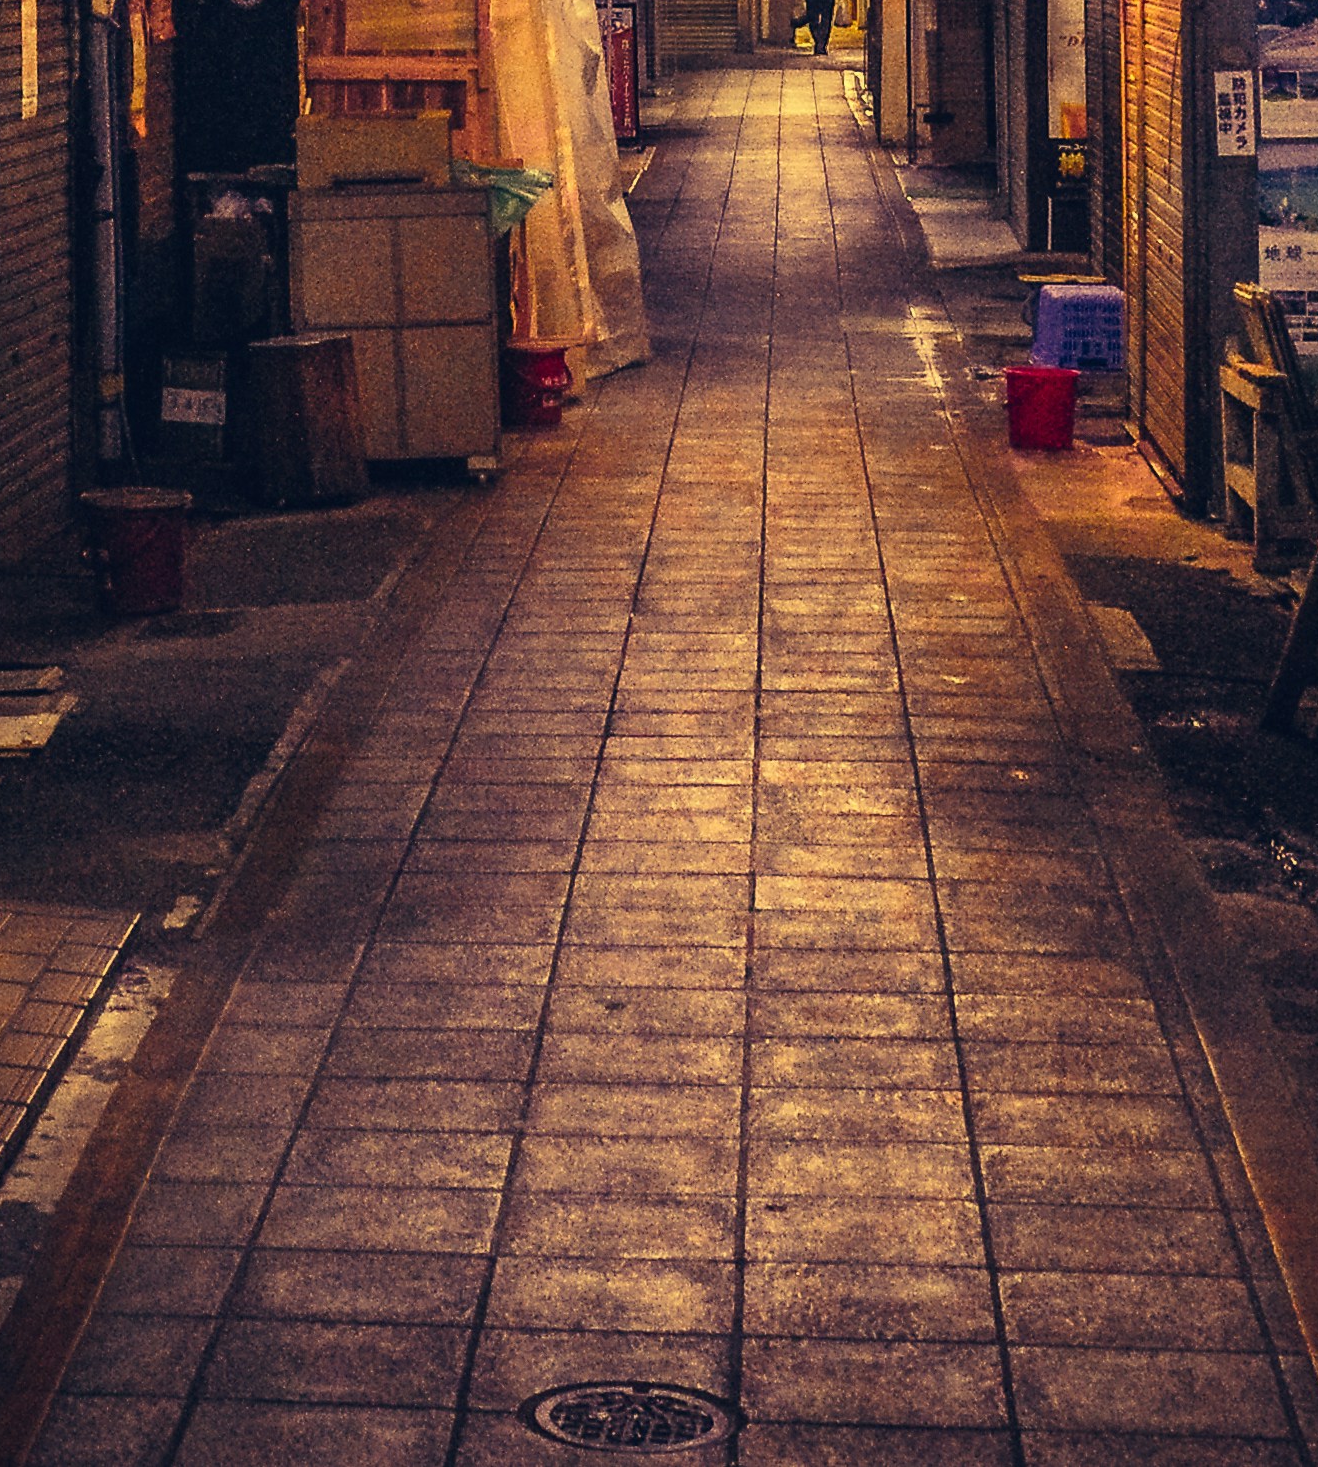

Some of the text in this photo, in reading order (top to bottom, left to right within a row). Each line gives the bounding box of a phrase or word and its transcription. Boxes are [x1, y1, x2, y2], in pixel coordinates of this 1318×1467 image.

[1232, 76, 1249, 151] 防犯カメラ
